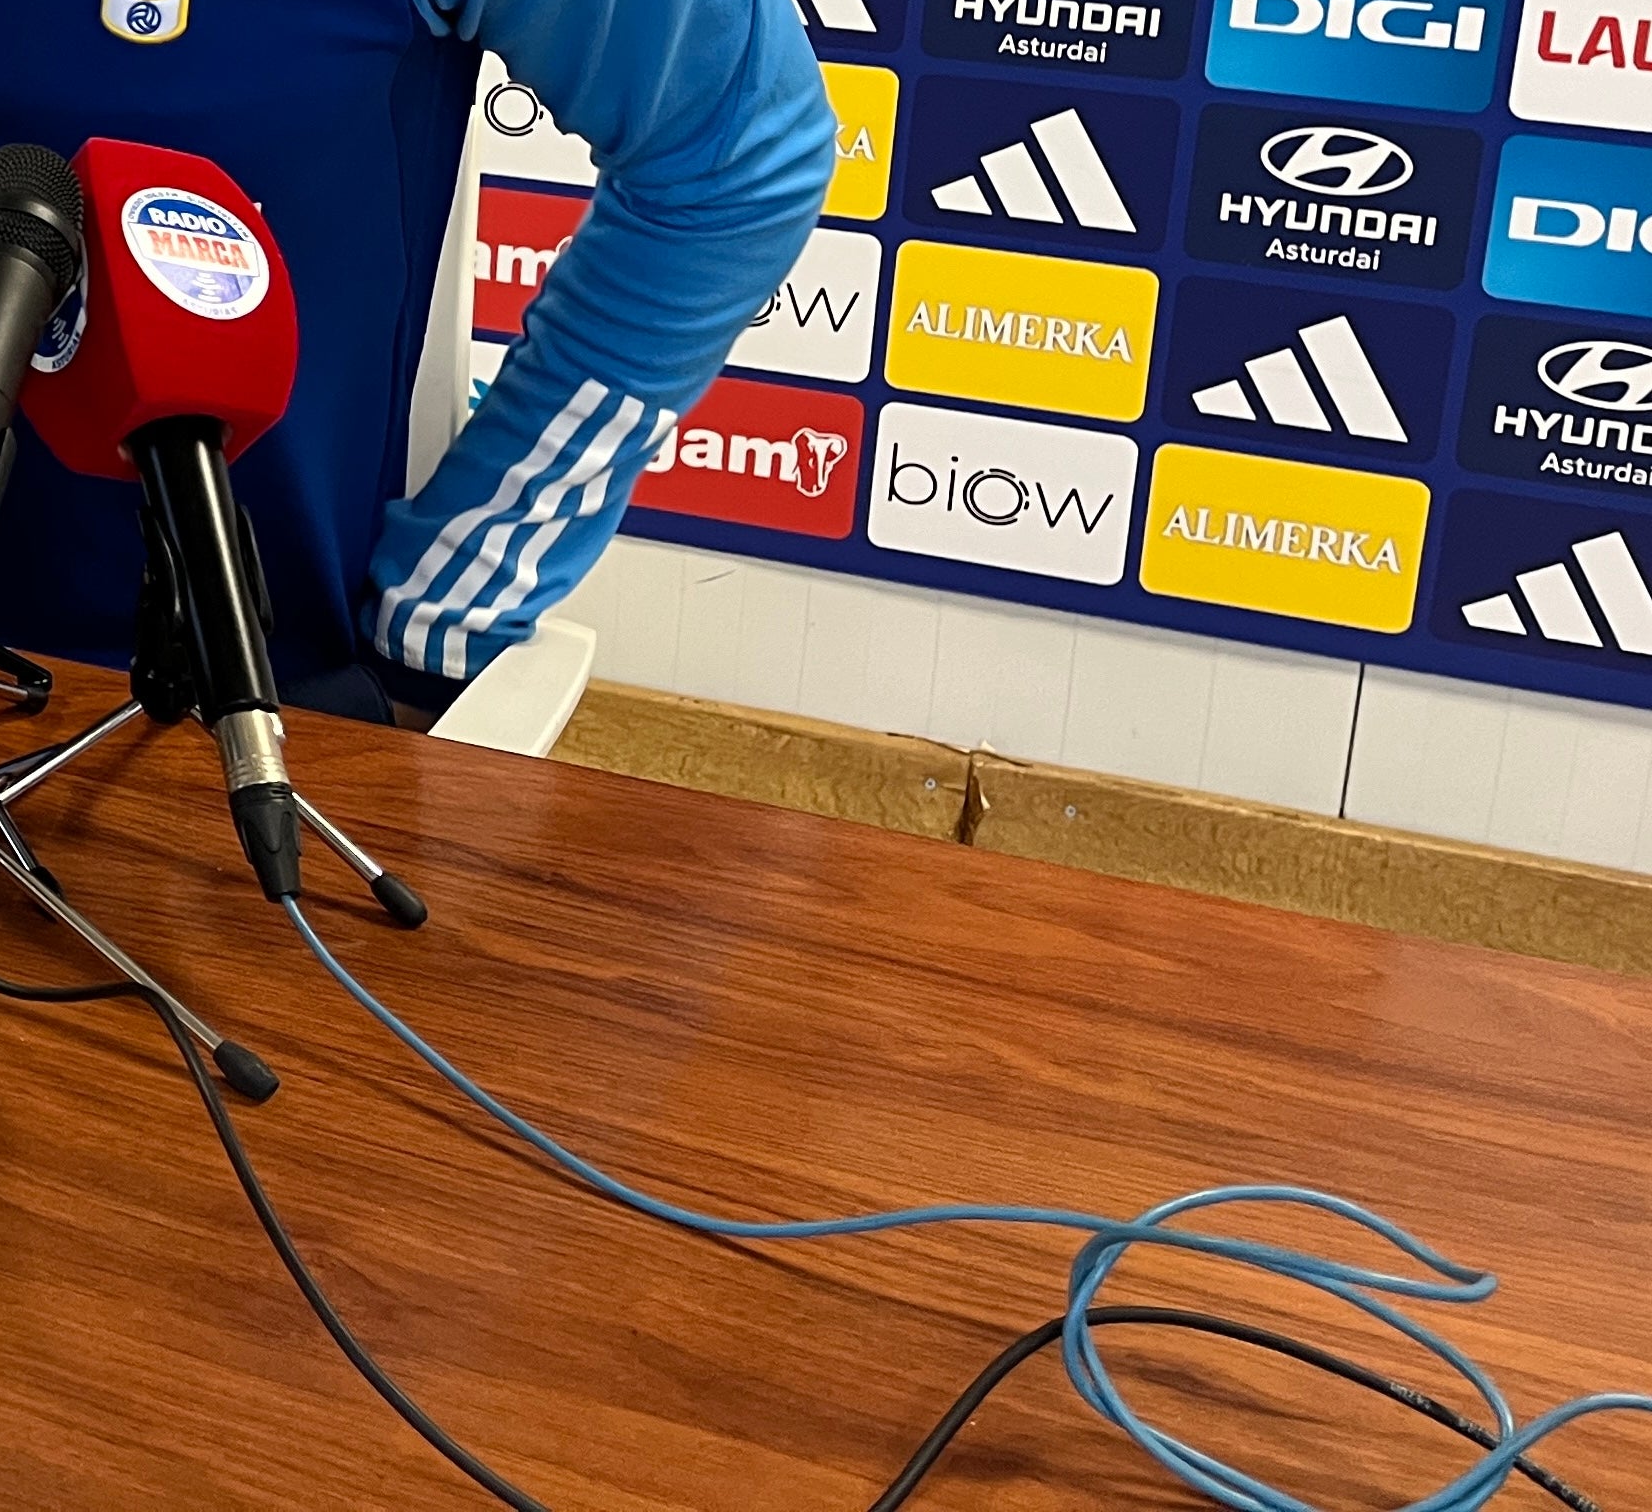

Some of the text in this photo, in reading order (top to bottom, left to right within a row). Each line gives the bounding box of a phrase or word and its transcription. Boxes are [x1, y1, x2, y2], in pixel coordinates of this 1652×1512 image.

[999, 34, 1106, 62] Asturdai
[148, 207, 227, 235] RADIO
[1220, 193, 1436, 245] HYUNDAI
[148, 229, 250, 270] MARCA
[1266, 239, 1380, 270] Asturdai
[906, 301, 1133, 363] ALIMERKA
[1163, 505, 1400, 574] ALIMERKA
